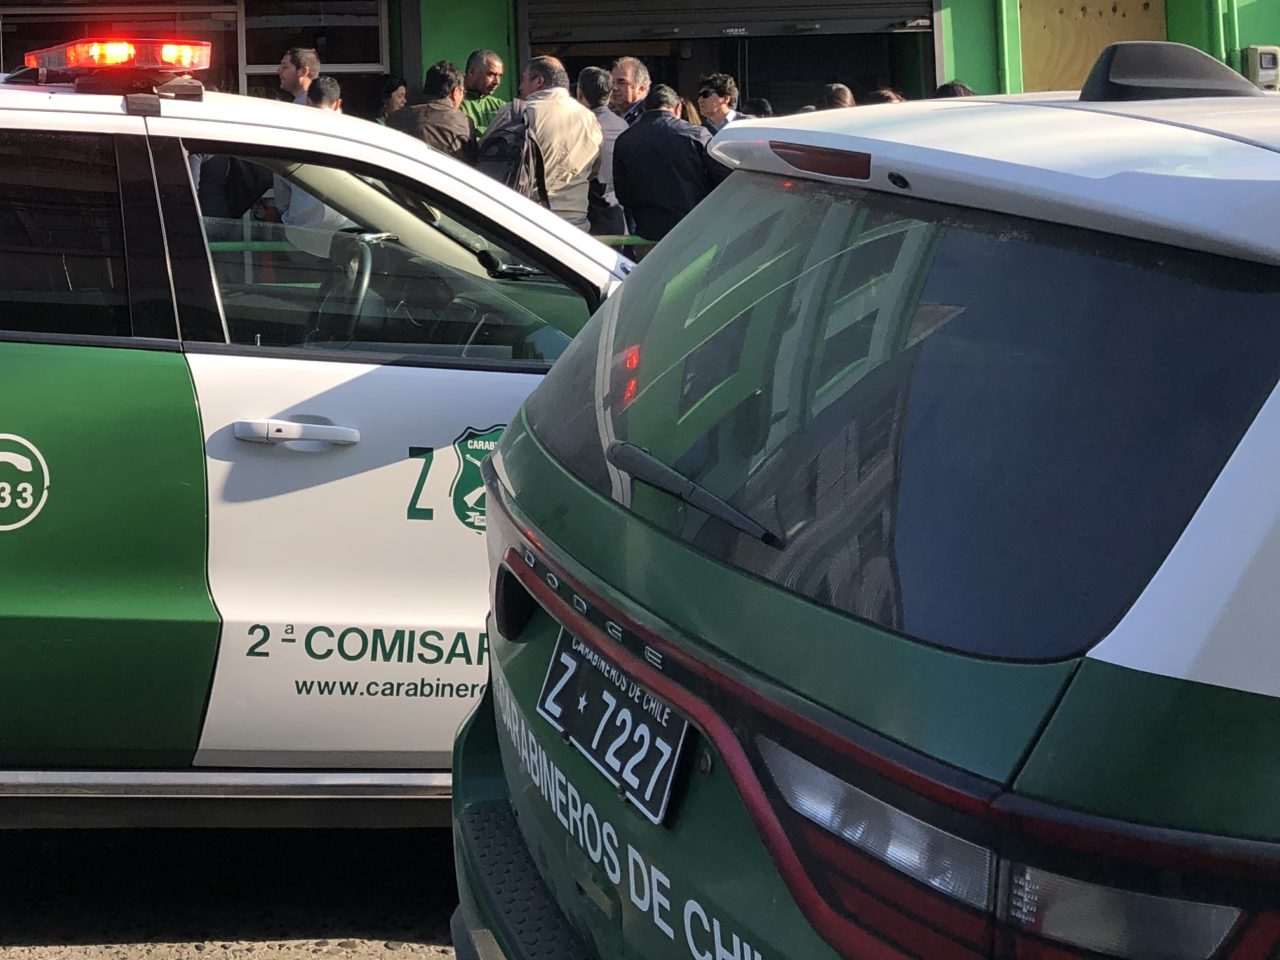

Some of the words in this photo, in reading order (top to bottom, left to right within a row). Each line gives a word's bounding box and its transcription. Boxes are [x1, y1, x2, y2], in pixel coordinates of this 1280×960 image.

[407, 446, 434, 521] Z
[467, 440, 497, 451] CARAB
[523, 550, 663, 670] DODGE
[544, 652, 577, 719] Z
[591, 690, 672, 802] 7227
[571, 636, 627, 693] CARABINEROS
[628, 682, 641, 704] DE
[642, 693, 671, 728] CHILE
[497, 676, 620, 885] CARABINEROS
[627, 843, 674, 940] DE
